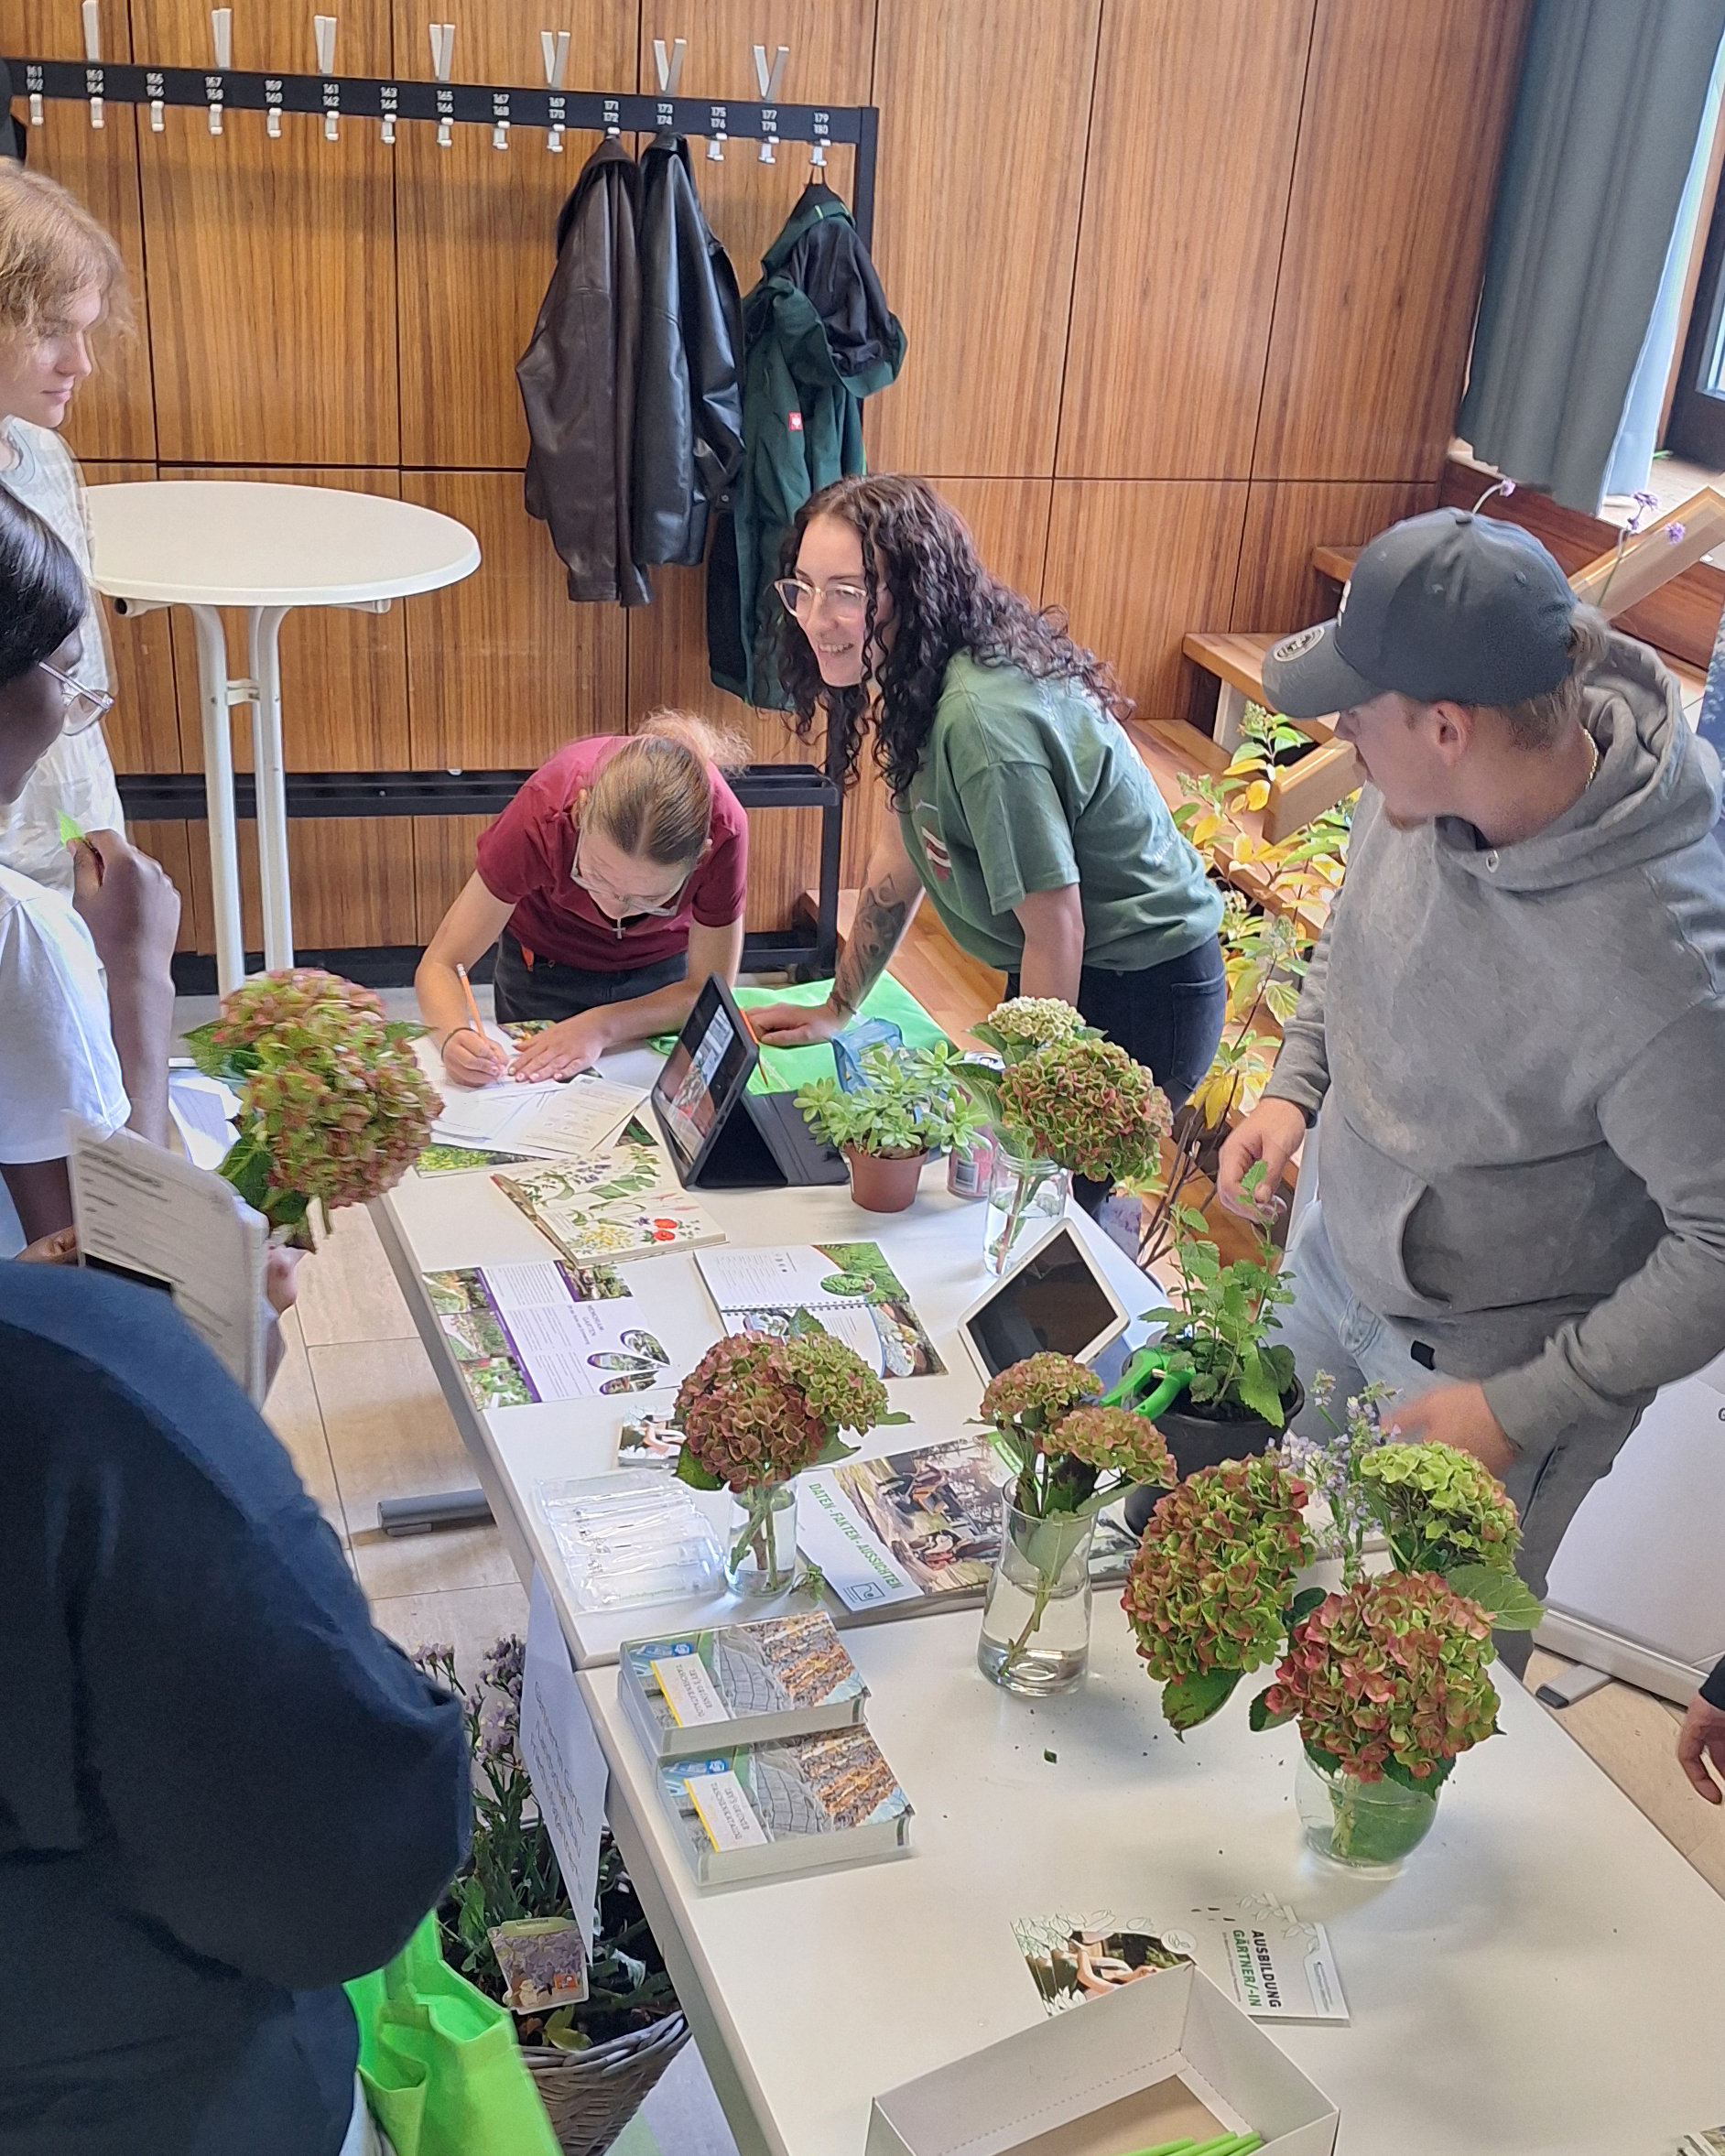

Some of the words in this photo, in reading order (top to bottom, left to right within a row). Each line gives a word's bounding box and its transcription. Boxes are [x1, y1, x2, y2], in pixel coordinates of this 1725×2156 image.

[205, 77, 222, 87] 157
[266, 81, 282, 91] 159
[323, 84, 339, 93] 161
[381, 87, 397, 97] 163
[207, 89, 223, 100] 158
[266, 92, 282, 103] 160
[437, 91, 453, 101] 165
[494, 94, 509, 103] 167
[323, 96, 339, 106] 162
[381, 100, 397, 109] 164
[549, 97, 565, 107] 169
[604, 101, 618, 110] 171
[437, 103, 453, 113] 166
[494, 106, 509, 115] 168
[657, 103, 673, 114] 173
[711, 107, 726, 117] 175
[548, 109, 565, 119] 170
[603, 113, 619, 123] 172
[762, 110, 777, 120] 177
[814, 113, 829, 123] 179
[656, 115, 672, 125] 174
[711, 118, 725, 128] 176
[762, 121, 776, 132] 178
[813, 125, 829, 135] 180
[808, 1483, 836, 1509] DATEN
[830, 1512, 862, 1541] FAKTEN
[856, 1544, 905, 1588] AUSSICHTEN
[1232, 1929, 1262, 2007] GÄRTNER/-IN
[1252, 1929, 1282, 2008] AUSBILDUNG
